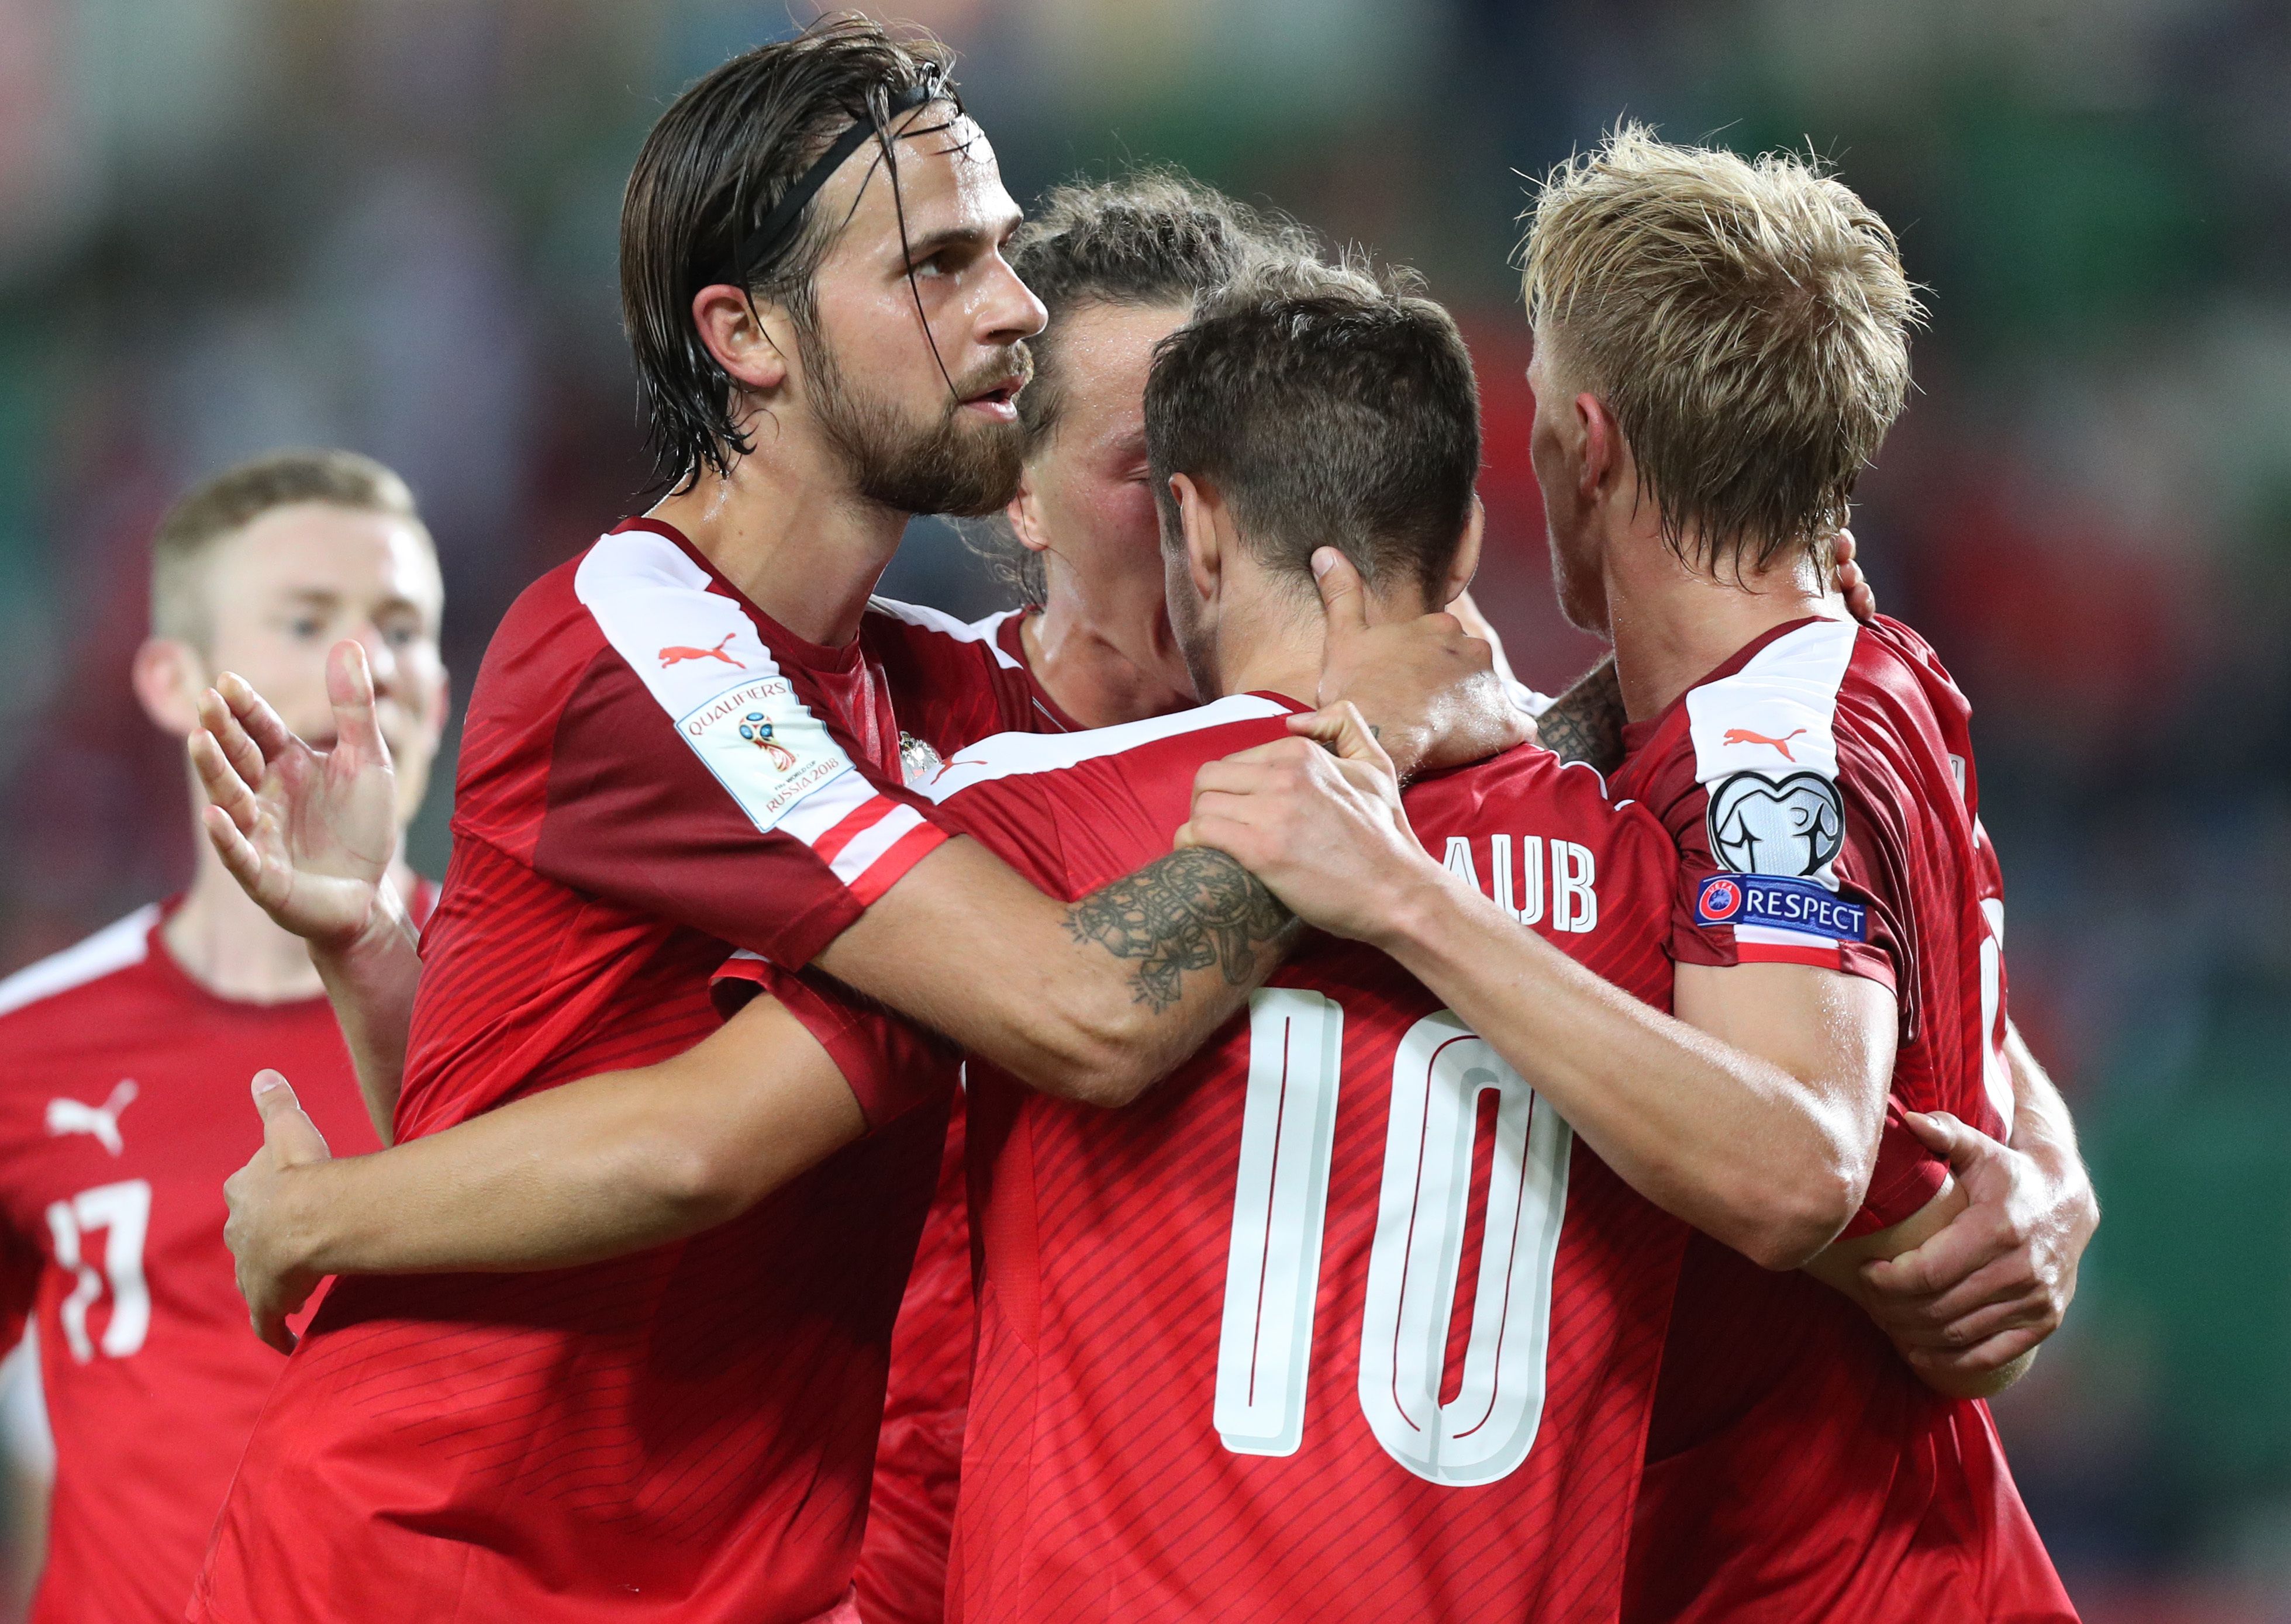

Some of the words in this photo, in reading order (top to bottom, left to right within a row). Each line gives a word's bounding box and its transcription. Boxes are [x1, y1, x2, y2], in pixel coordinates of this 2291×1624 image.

[689, 682, 787, 736] QUALIFIERS
[766, 777, 813, 813] RUSSIA
[810, 758, 839, 781] 2018
[786, 766, 807, 783] WORLD
[806, 760, 816, 769] CUP
[1708, 882, 1733, 893] UEFA
[1746, 889, 1865, 933] RESPECT
[1213, 987, 1574, 1487] 10
[44, 1177, 153, 1367] 17
